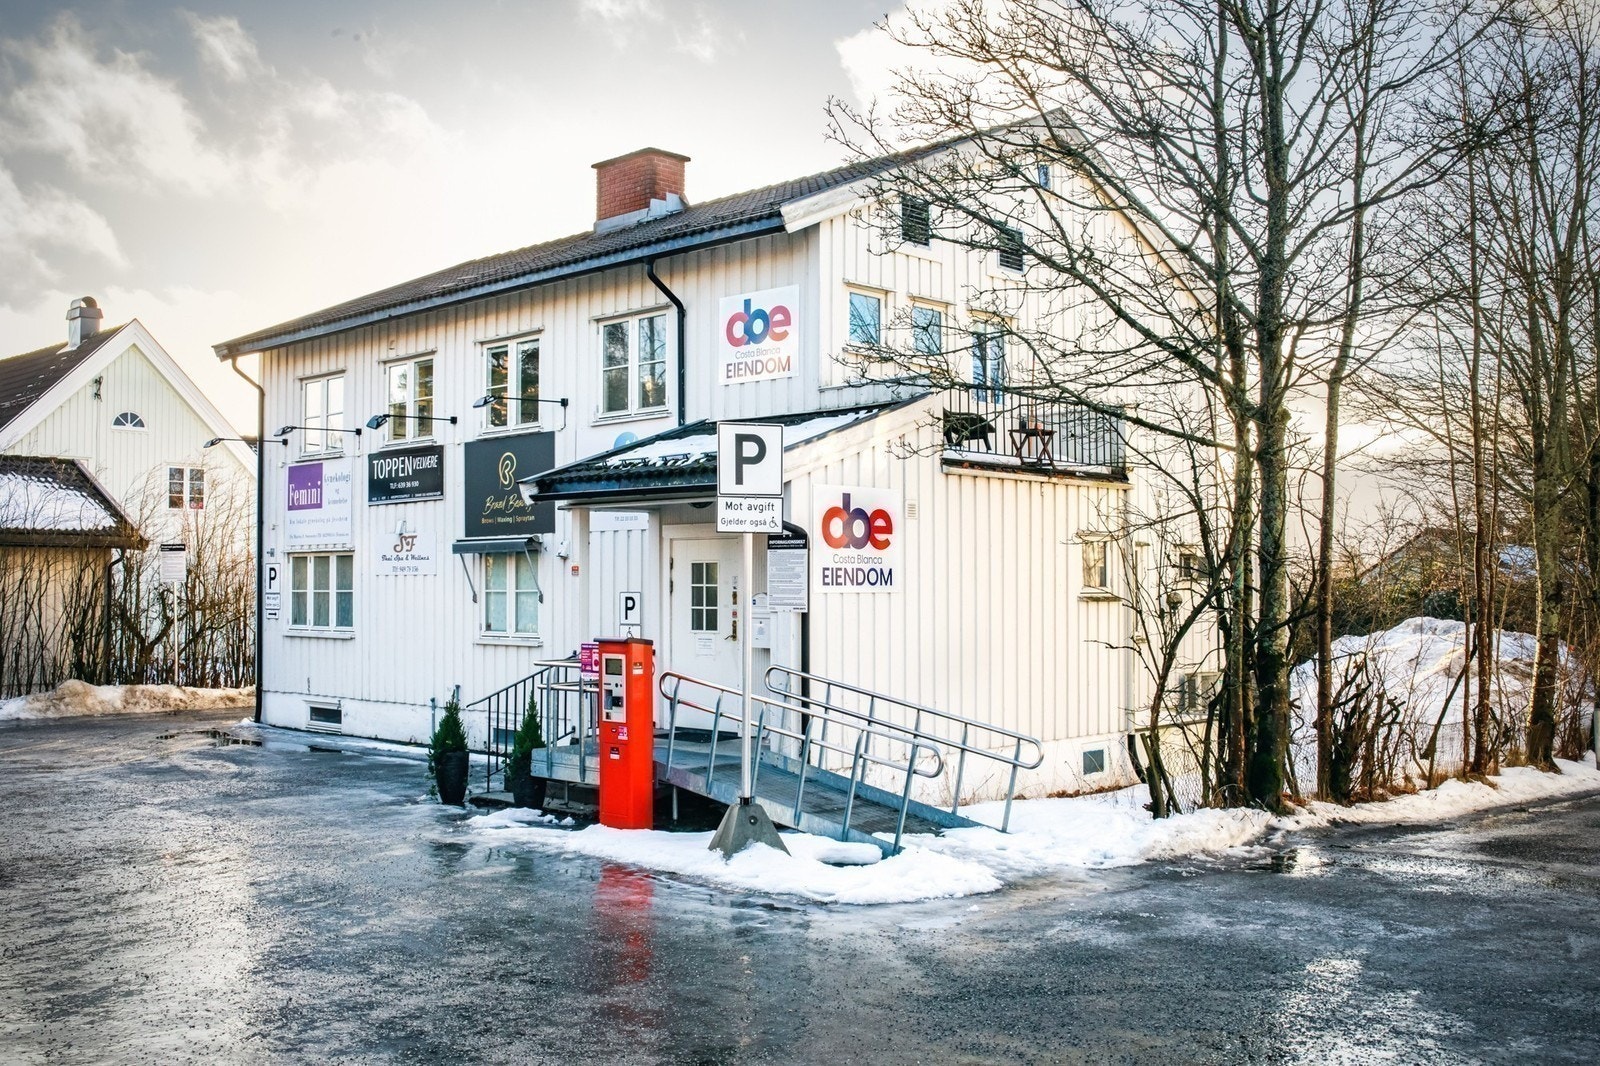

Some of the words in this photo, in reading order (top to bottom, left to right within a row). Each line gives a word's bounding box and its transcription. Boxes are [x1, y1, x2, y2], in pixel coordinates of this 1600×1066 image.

[735, 349, 755, 359] Costa
[756, 347, 781, 356] Blanca
[726, 356, 791, 379] EIENDOM
[373, 456, 412, 479] TOPPEN
[413, 455, 438, 470] VELVÆRE
[735, 433, 767, 485] P
[289, 480, 321, 506] Femini
[725, 501, 743, 511] Mot
[747, 501, 775, 513] avgift
[515, 515, 535, 523] Spraytan
[721, 517, 747, 527] Gjelder
[749, 518, 767, 527] også
[832, 553, 856, 564] Costa
[857, 554, 883, 565] Blanca
[269, 567, 277, 589] P
[822, 567, 893, 586] EIENDOM
[625, 596, 636, 620] P
